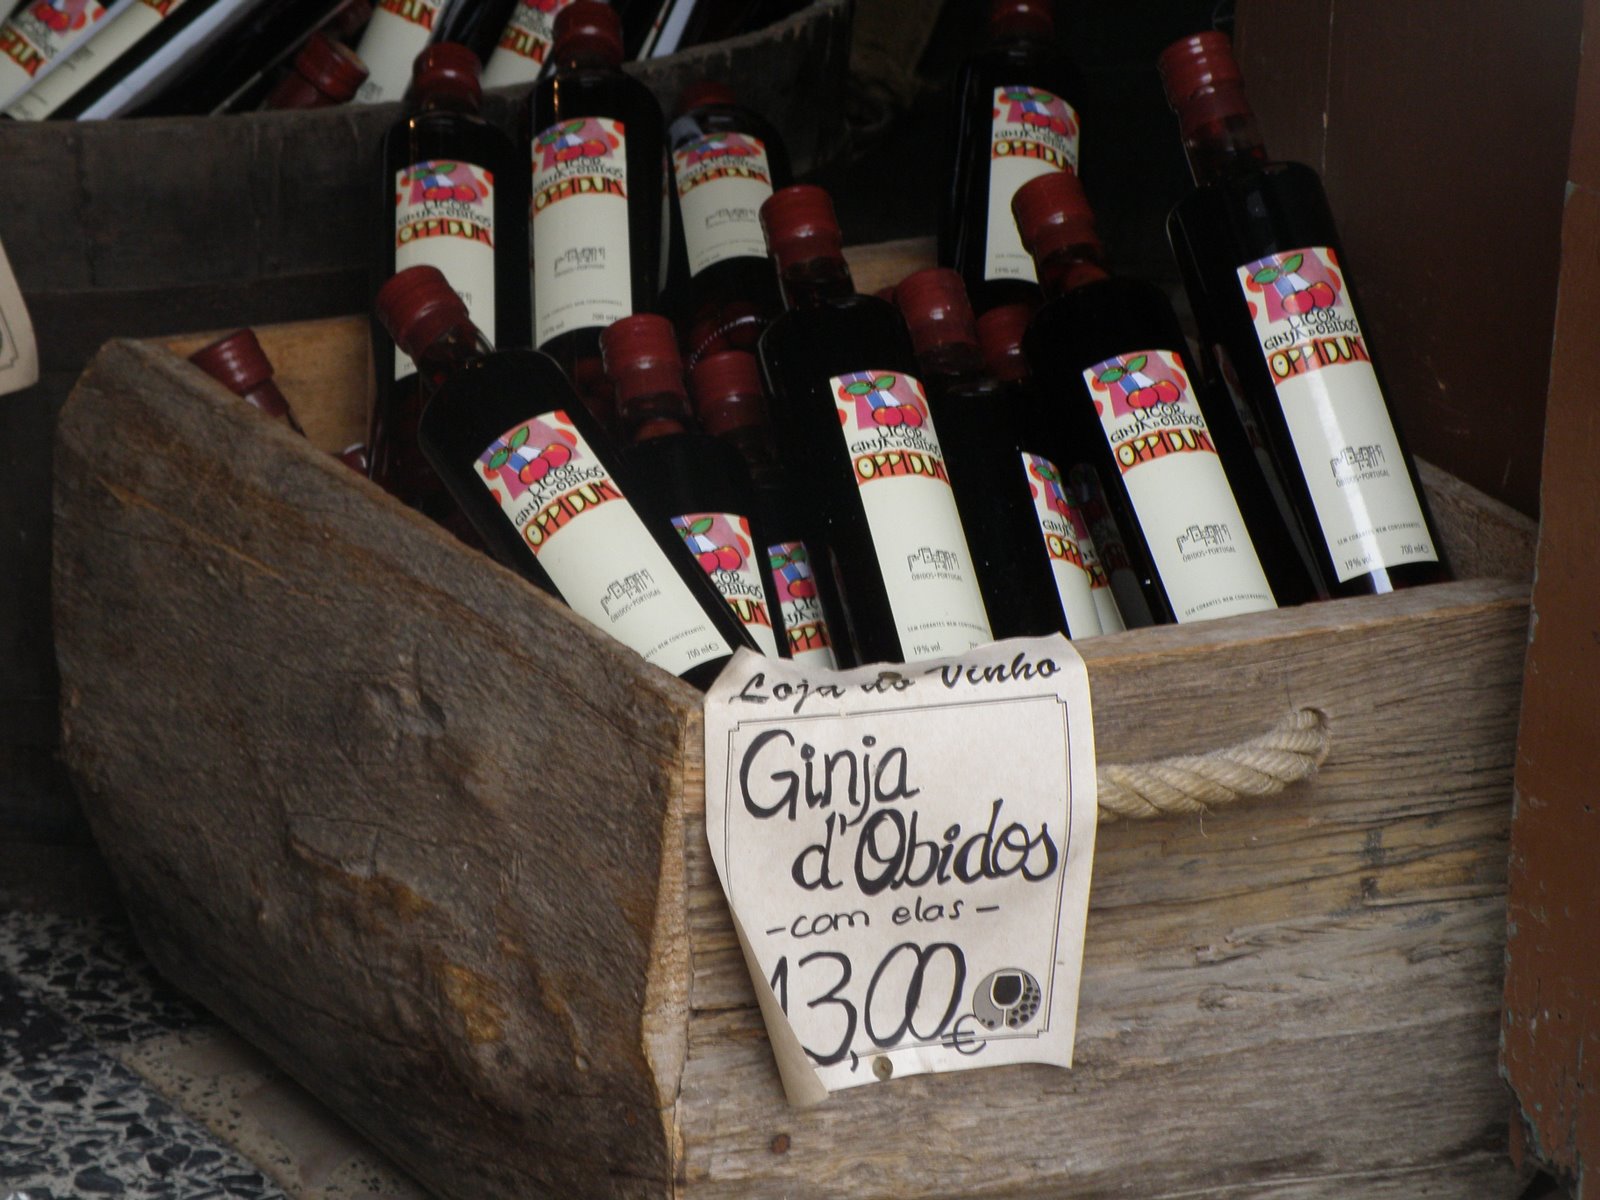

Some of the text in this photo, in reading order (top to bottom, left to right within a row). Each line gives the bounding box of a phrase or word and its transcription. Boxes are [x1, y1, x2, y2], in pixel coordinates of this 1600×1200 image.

[681, 168, 769, 190] OPPIDUM
[534, 177, 626, 211] OPPIDUM
[399, 219, 493, 247] OPPIDUM
[1287, 308, 1340, 332] LICOR
[1264, 324, 1310, 350] GINJA
[1271, 335, 1370, 378] OPPIDUM
[1110, 416, 1154, 443] GINJA
[1132, 404, 1186, 427] LICOR
[851, 438, 894, 454] GINJA
[876, 424, 926, 440] LICOR
[1117, 428, 1216, 467] OPPIDUM
[528, 464, 581, 497] LICOR
[856, 450, 949, 484] OPPIDUM
[515, 494, 549, 527] GINJA
[525, 480, 622, 546] OPPIDUM
[1400, 545, 1413, 555] 700
[728, 672, 846, 714] Loja
[924, 651, 1062, 689] Vinho
[739, 729, 920, 825] Ginja
[891, 896, 965, 925] elas
